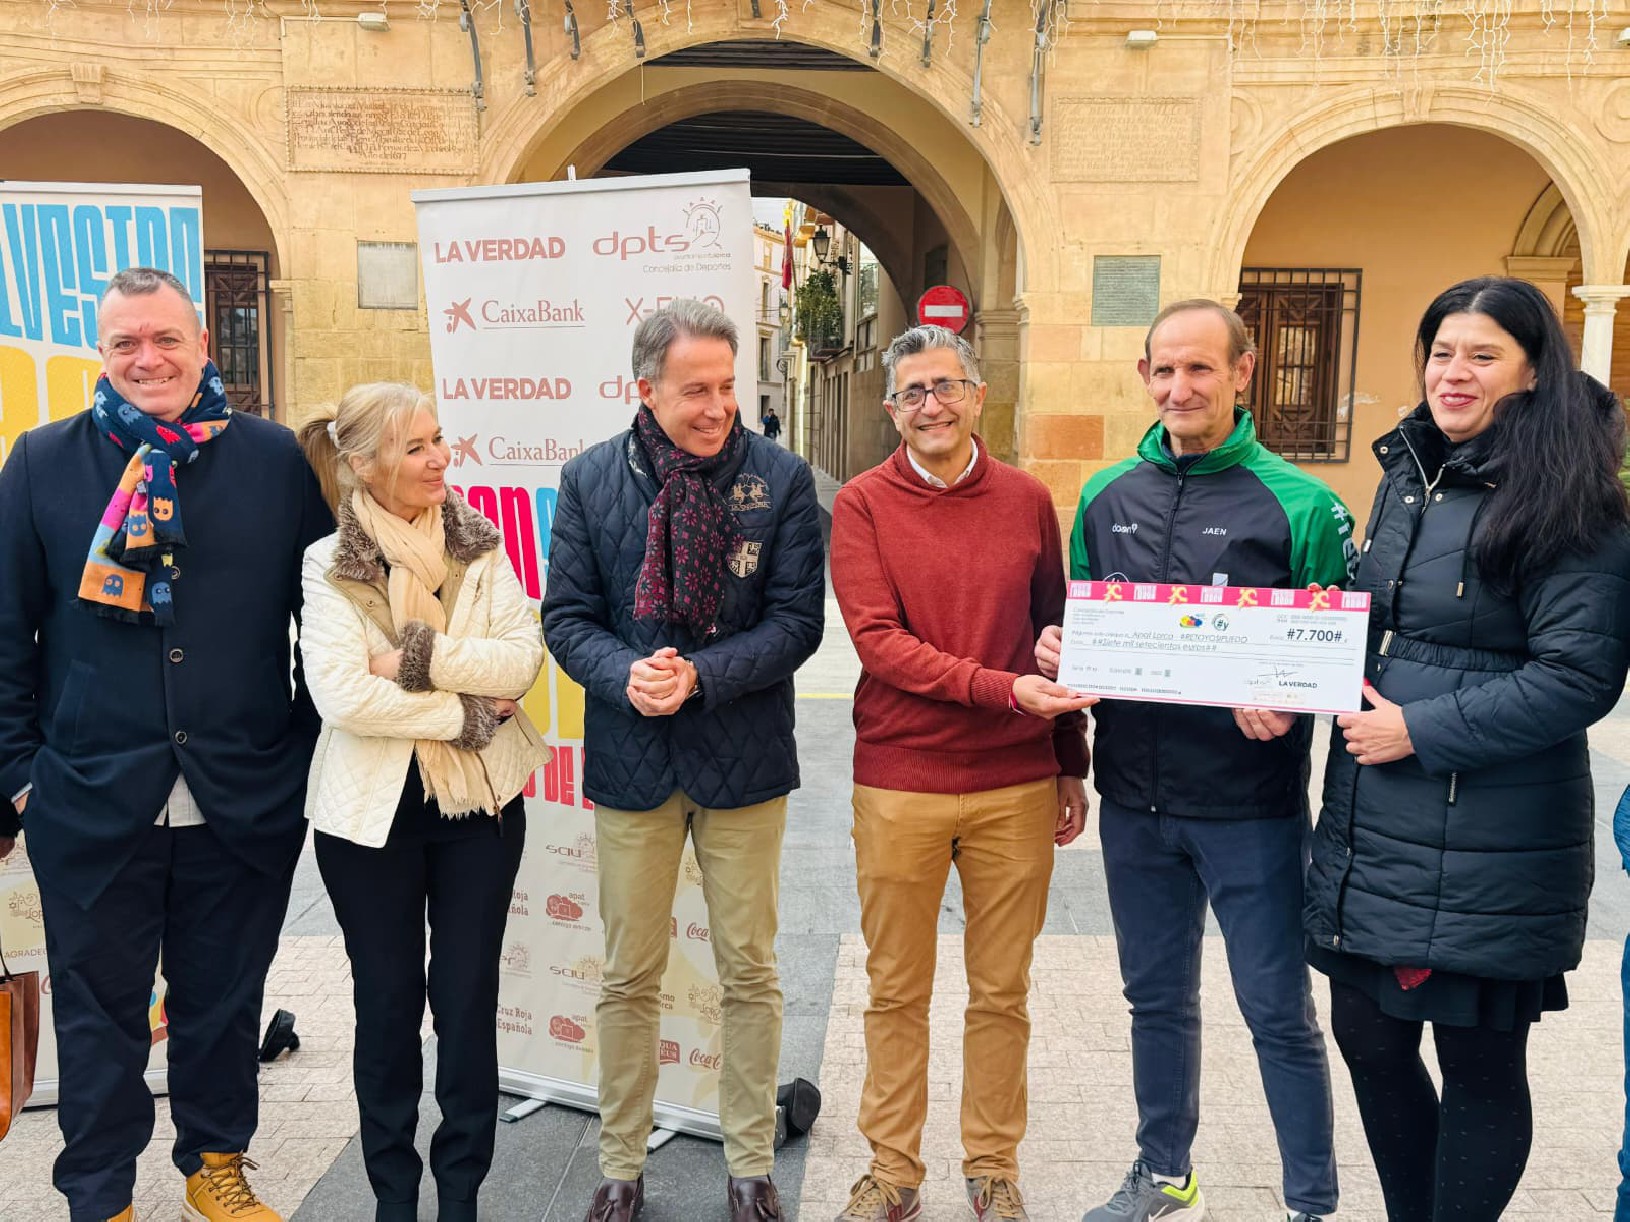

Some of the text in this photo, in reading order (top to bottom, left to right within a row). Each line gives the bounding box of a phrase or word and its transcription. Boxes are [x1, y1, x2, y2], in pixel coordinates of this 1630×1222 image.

[435, 236, 566, 264] LA VERDAD
[592, 226, 690, 261] dpts
[481, 299, 585, 324] CaixaBank
[443, 377, 572, 400] LA VERDAD
[1202, 527, 1227, 536] JAEN
[1286, 628, 1342, 643] #7.700#
[515, 1007, 532, 1021] Roja
